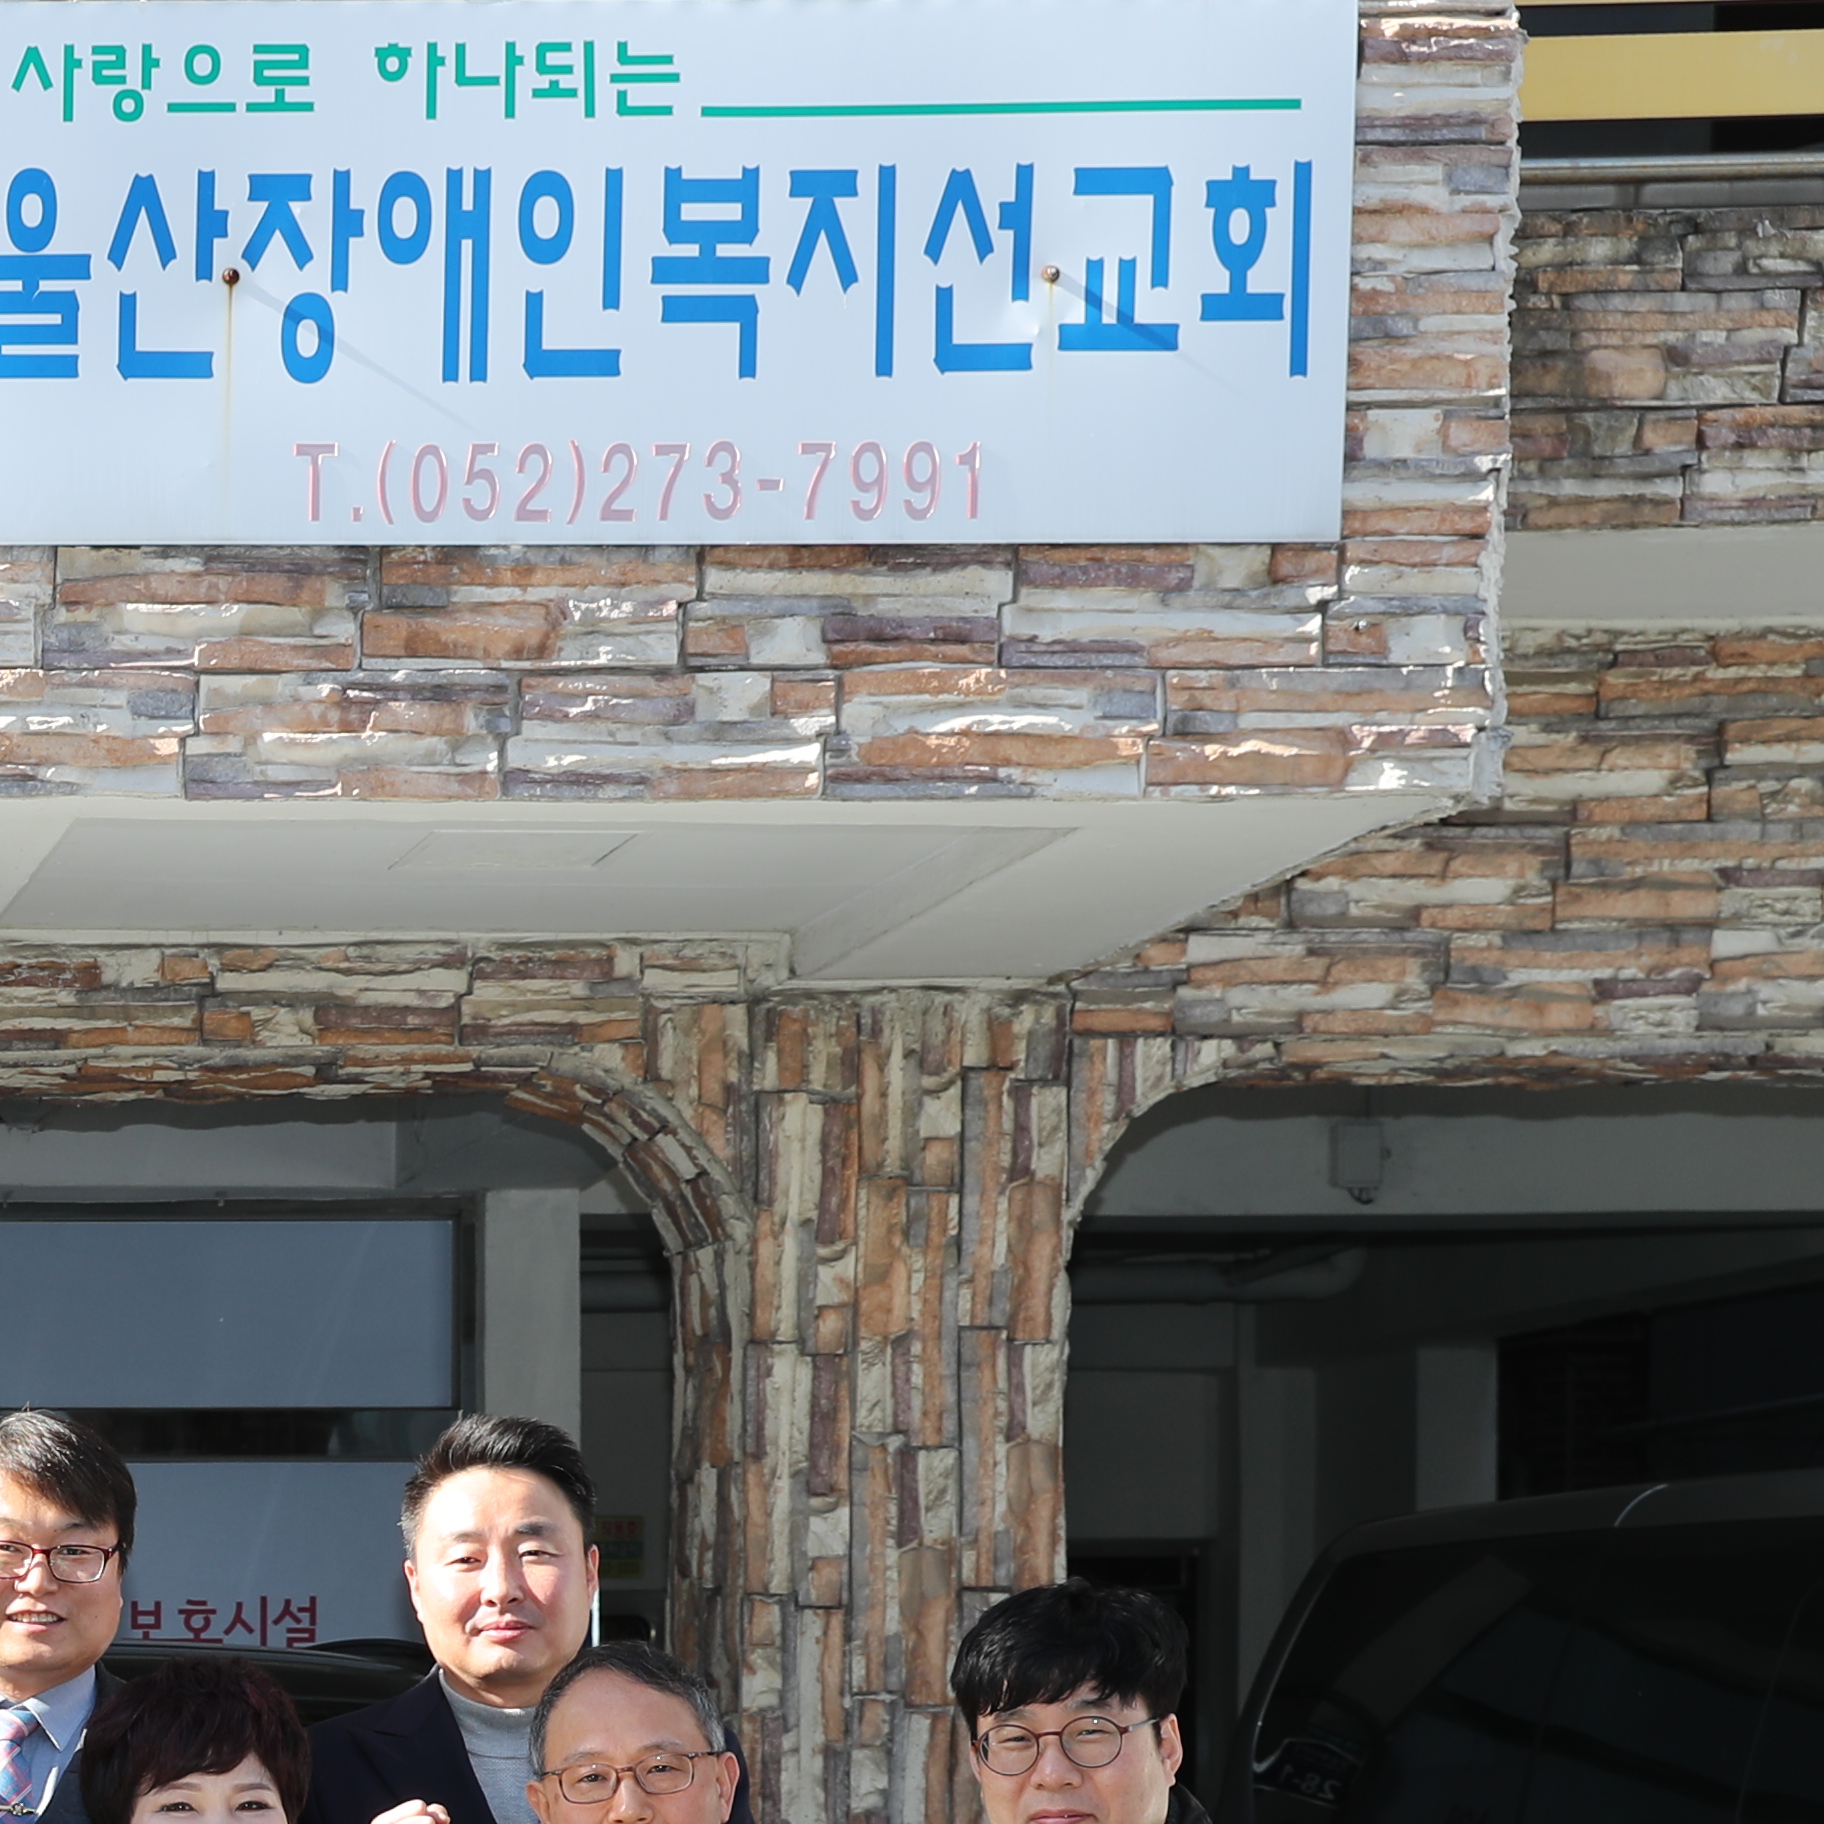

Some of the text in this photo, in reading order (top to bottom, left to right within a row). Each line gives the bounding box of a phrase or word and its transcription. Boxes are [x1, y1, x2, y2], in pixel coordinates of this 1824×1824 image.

[11, 41, 682, 122] 사랑으로 하나되는
[293, 440, 984, 524] T.(052)273-7991
